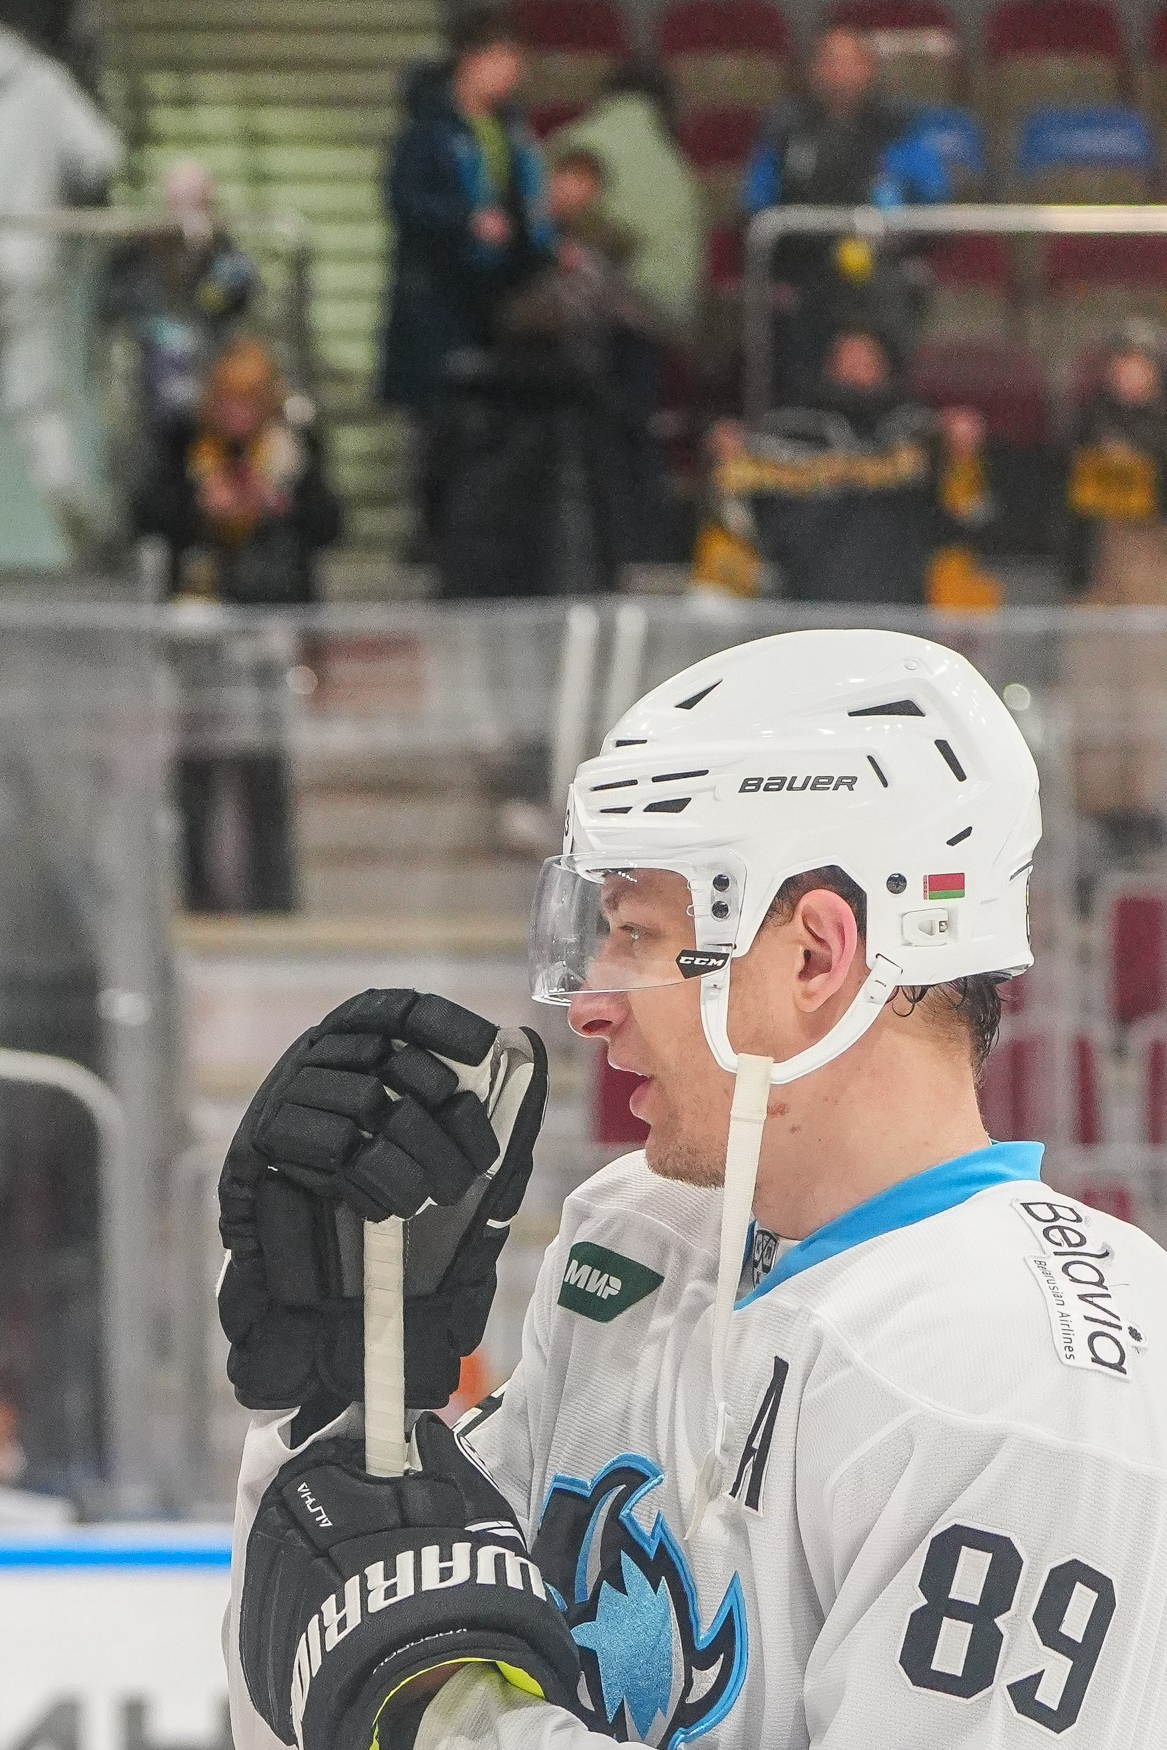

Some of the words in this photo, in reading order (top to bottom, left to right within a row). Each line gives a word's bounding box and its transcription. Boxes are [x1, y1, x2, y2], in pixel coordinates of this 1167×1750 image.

[738, 775, 858, 793] BAUER
[679, 954, 724, 969] CCM
[564, 1258, 622, 1299] МИР
[1019, 1201, 1142, 1375] Belavia
[1033, 1259, 1065, 1306] Belarusian
[1057, 1310, 1076, 1360] Airlines
[728, 1355, 789, 1516] A
[298, 1482, 333, 1528] ALPHA
[898, 1522, 1117, 1735] 89
